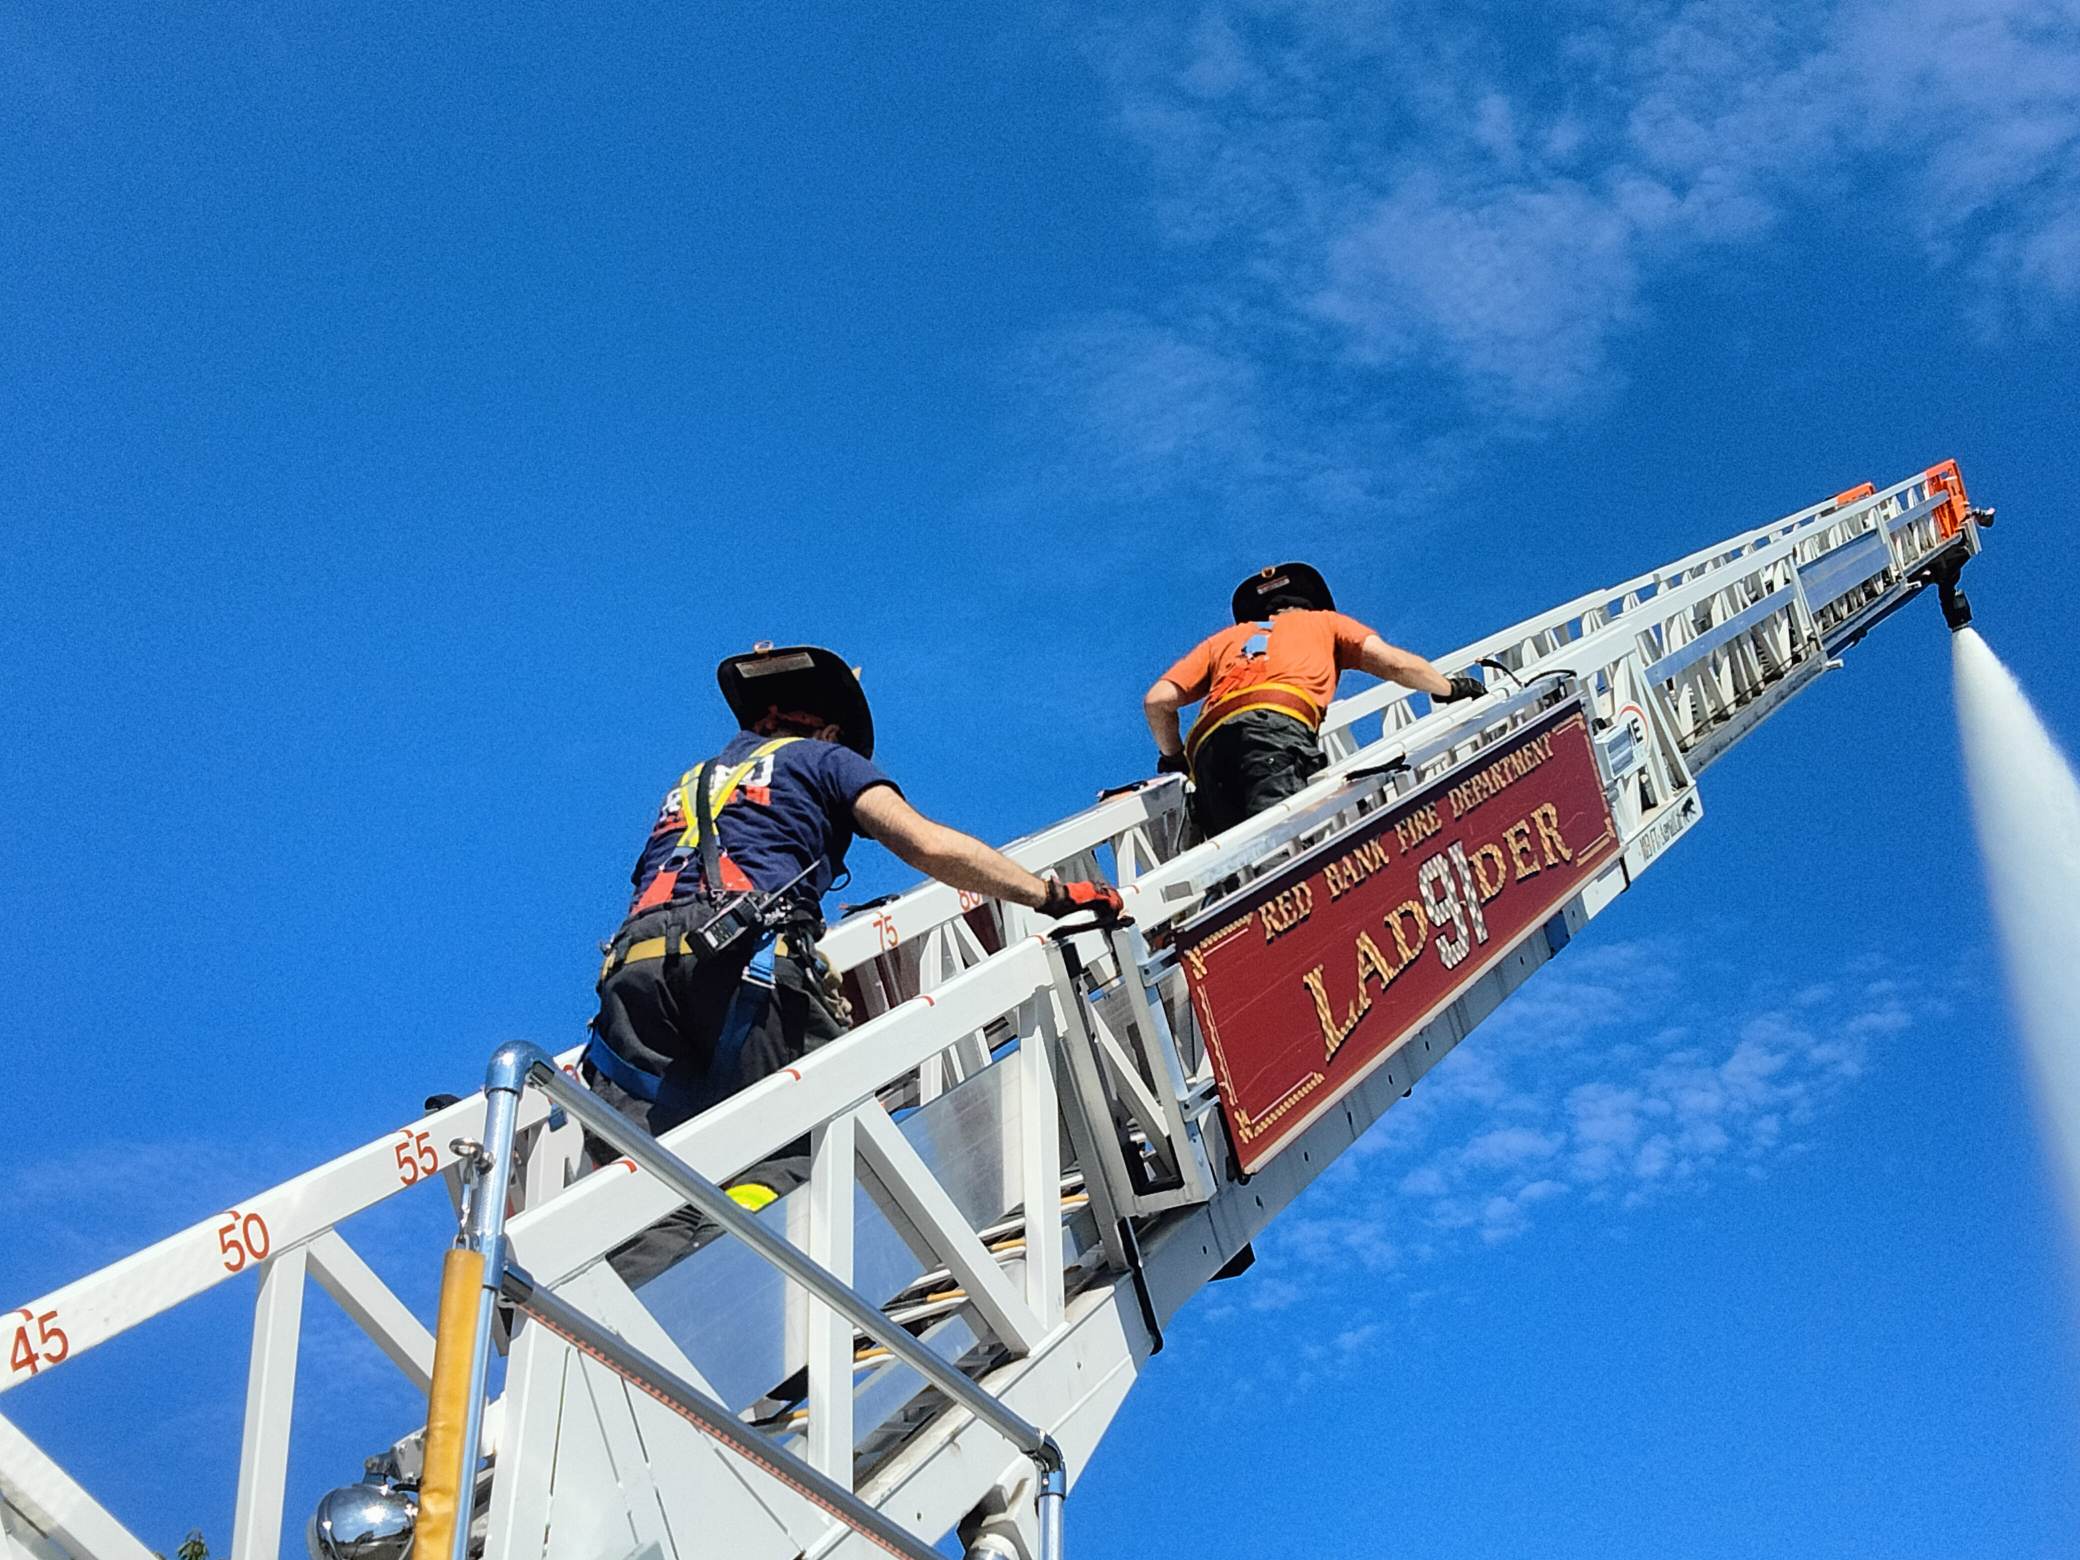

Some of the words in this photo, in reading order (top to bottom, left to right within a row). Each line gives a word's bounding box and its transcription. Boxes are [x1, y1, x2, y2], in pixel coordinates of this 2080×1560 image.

[1258, 881, 1313, 941] RED
[1322, 837, 1390, 898] BANK
[1394, 804, 1443, 853] FIRE
[1448, 733, 1554, 818] DEPARTMENT
[872, 915, 899, 951] 75
[1418, 841, 1489, 970] 91
[394, 1132, 439, 1186] 55
[219, 1212, 270, 1273] 50
[10, 1310, 69, 1374] 45
